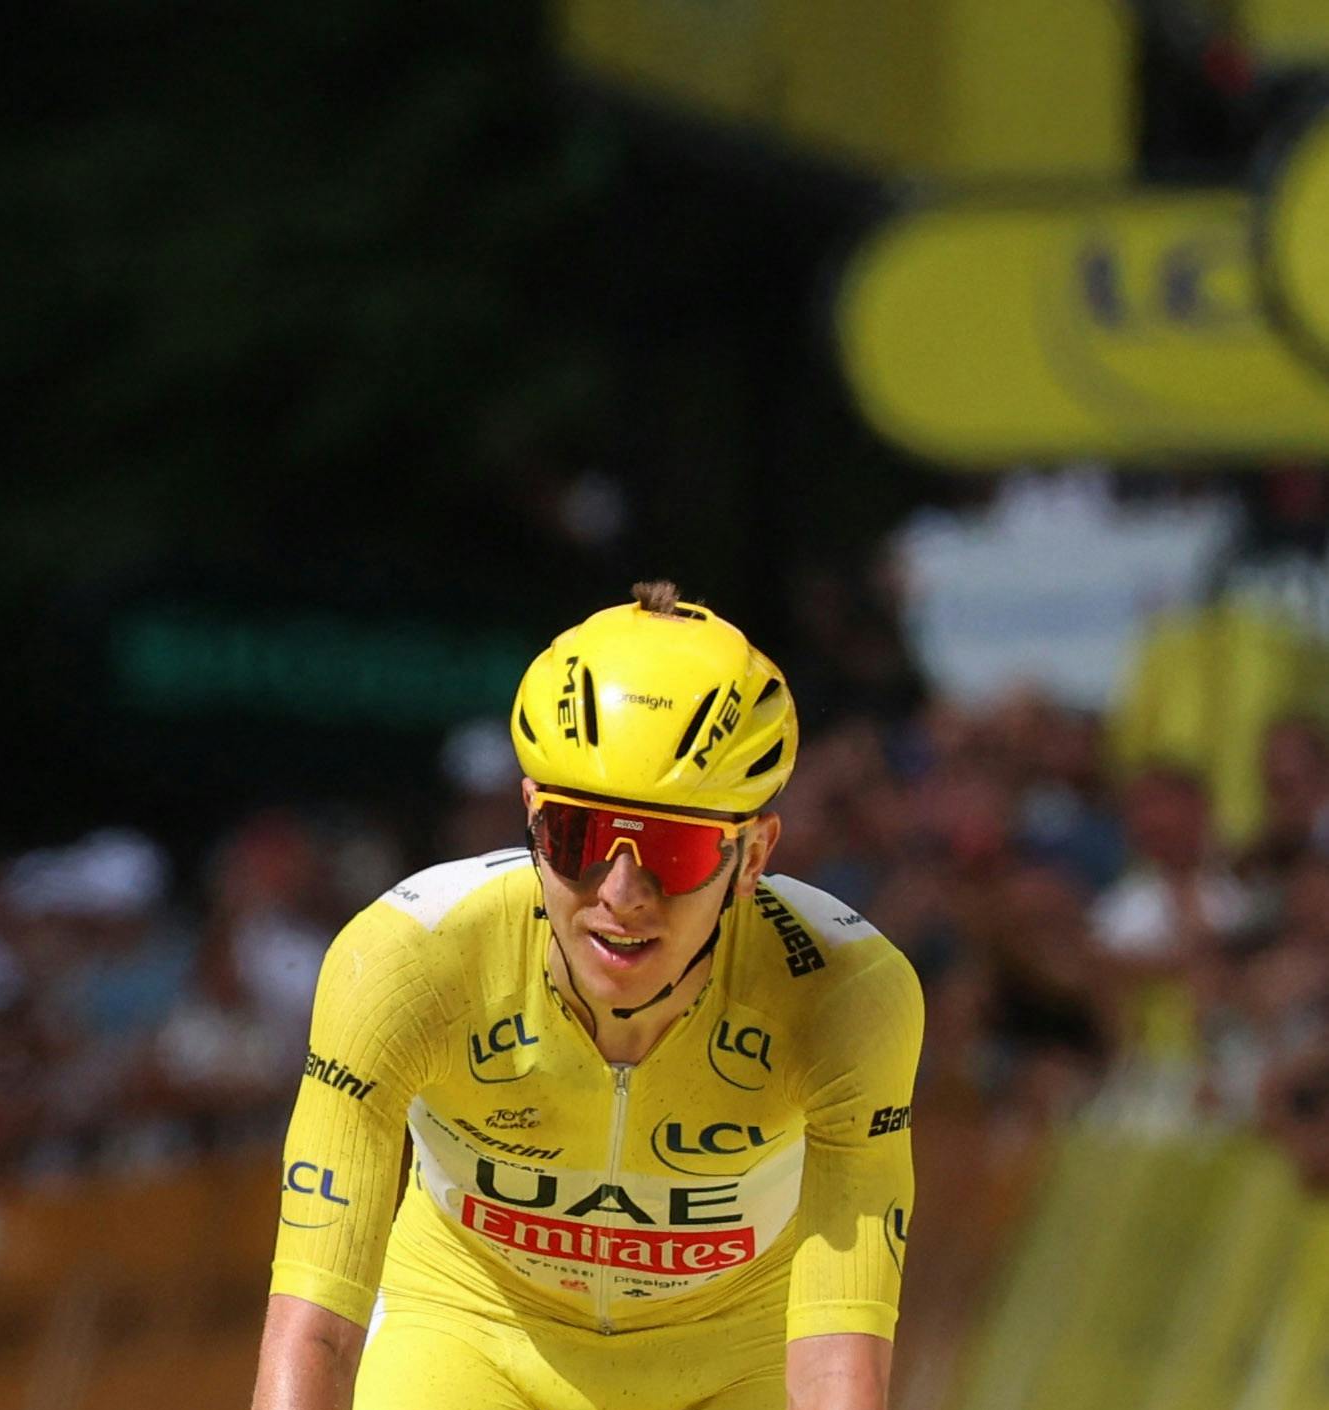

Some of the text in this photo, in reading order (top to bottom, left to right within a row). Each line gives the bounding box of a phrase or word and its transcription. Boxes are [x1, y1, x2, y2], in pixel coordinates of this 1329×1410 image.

[557, 656, 581, 748] MET
[692, 680, 743, 771] MET
[471, 1012, 539, 1064] LCL
[716, 1020, 772, 1073] LCL
[304, 1050, 377, 1101] antini
[451, 1117, 565, 1161] Santini
[281, 1160, 350, 1207] CL
[475, 1157, 744, 1226] UAE
[471, 1202, 747, 1271] Emirates
